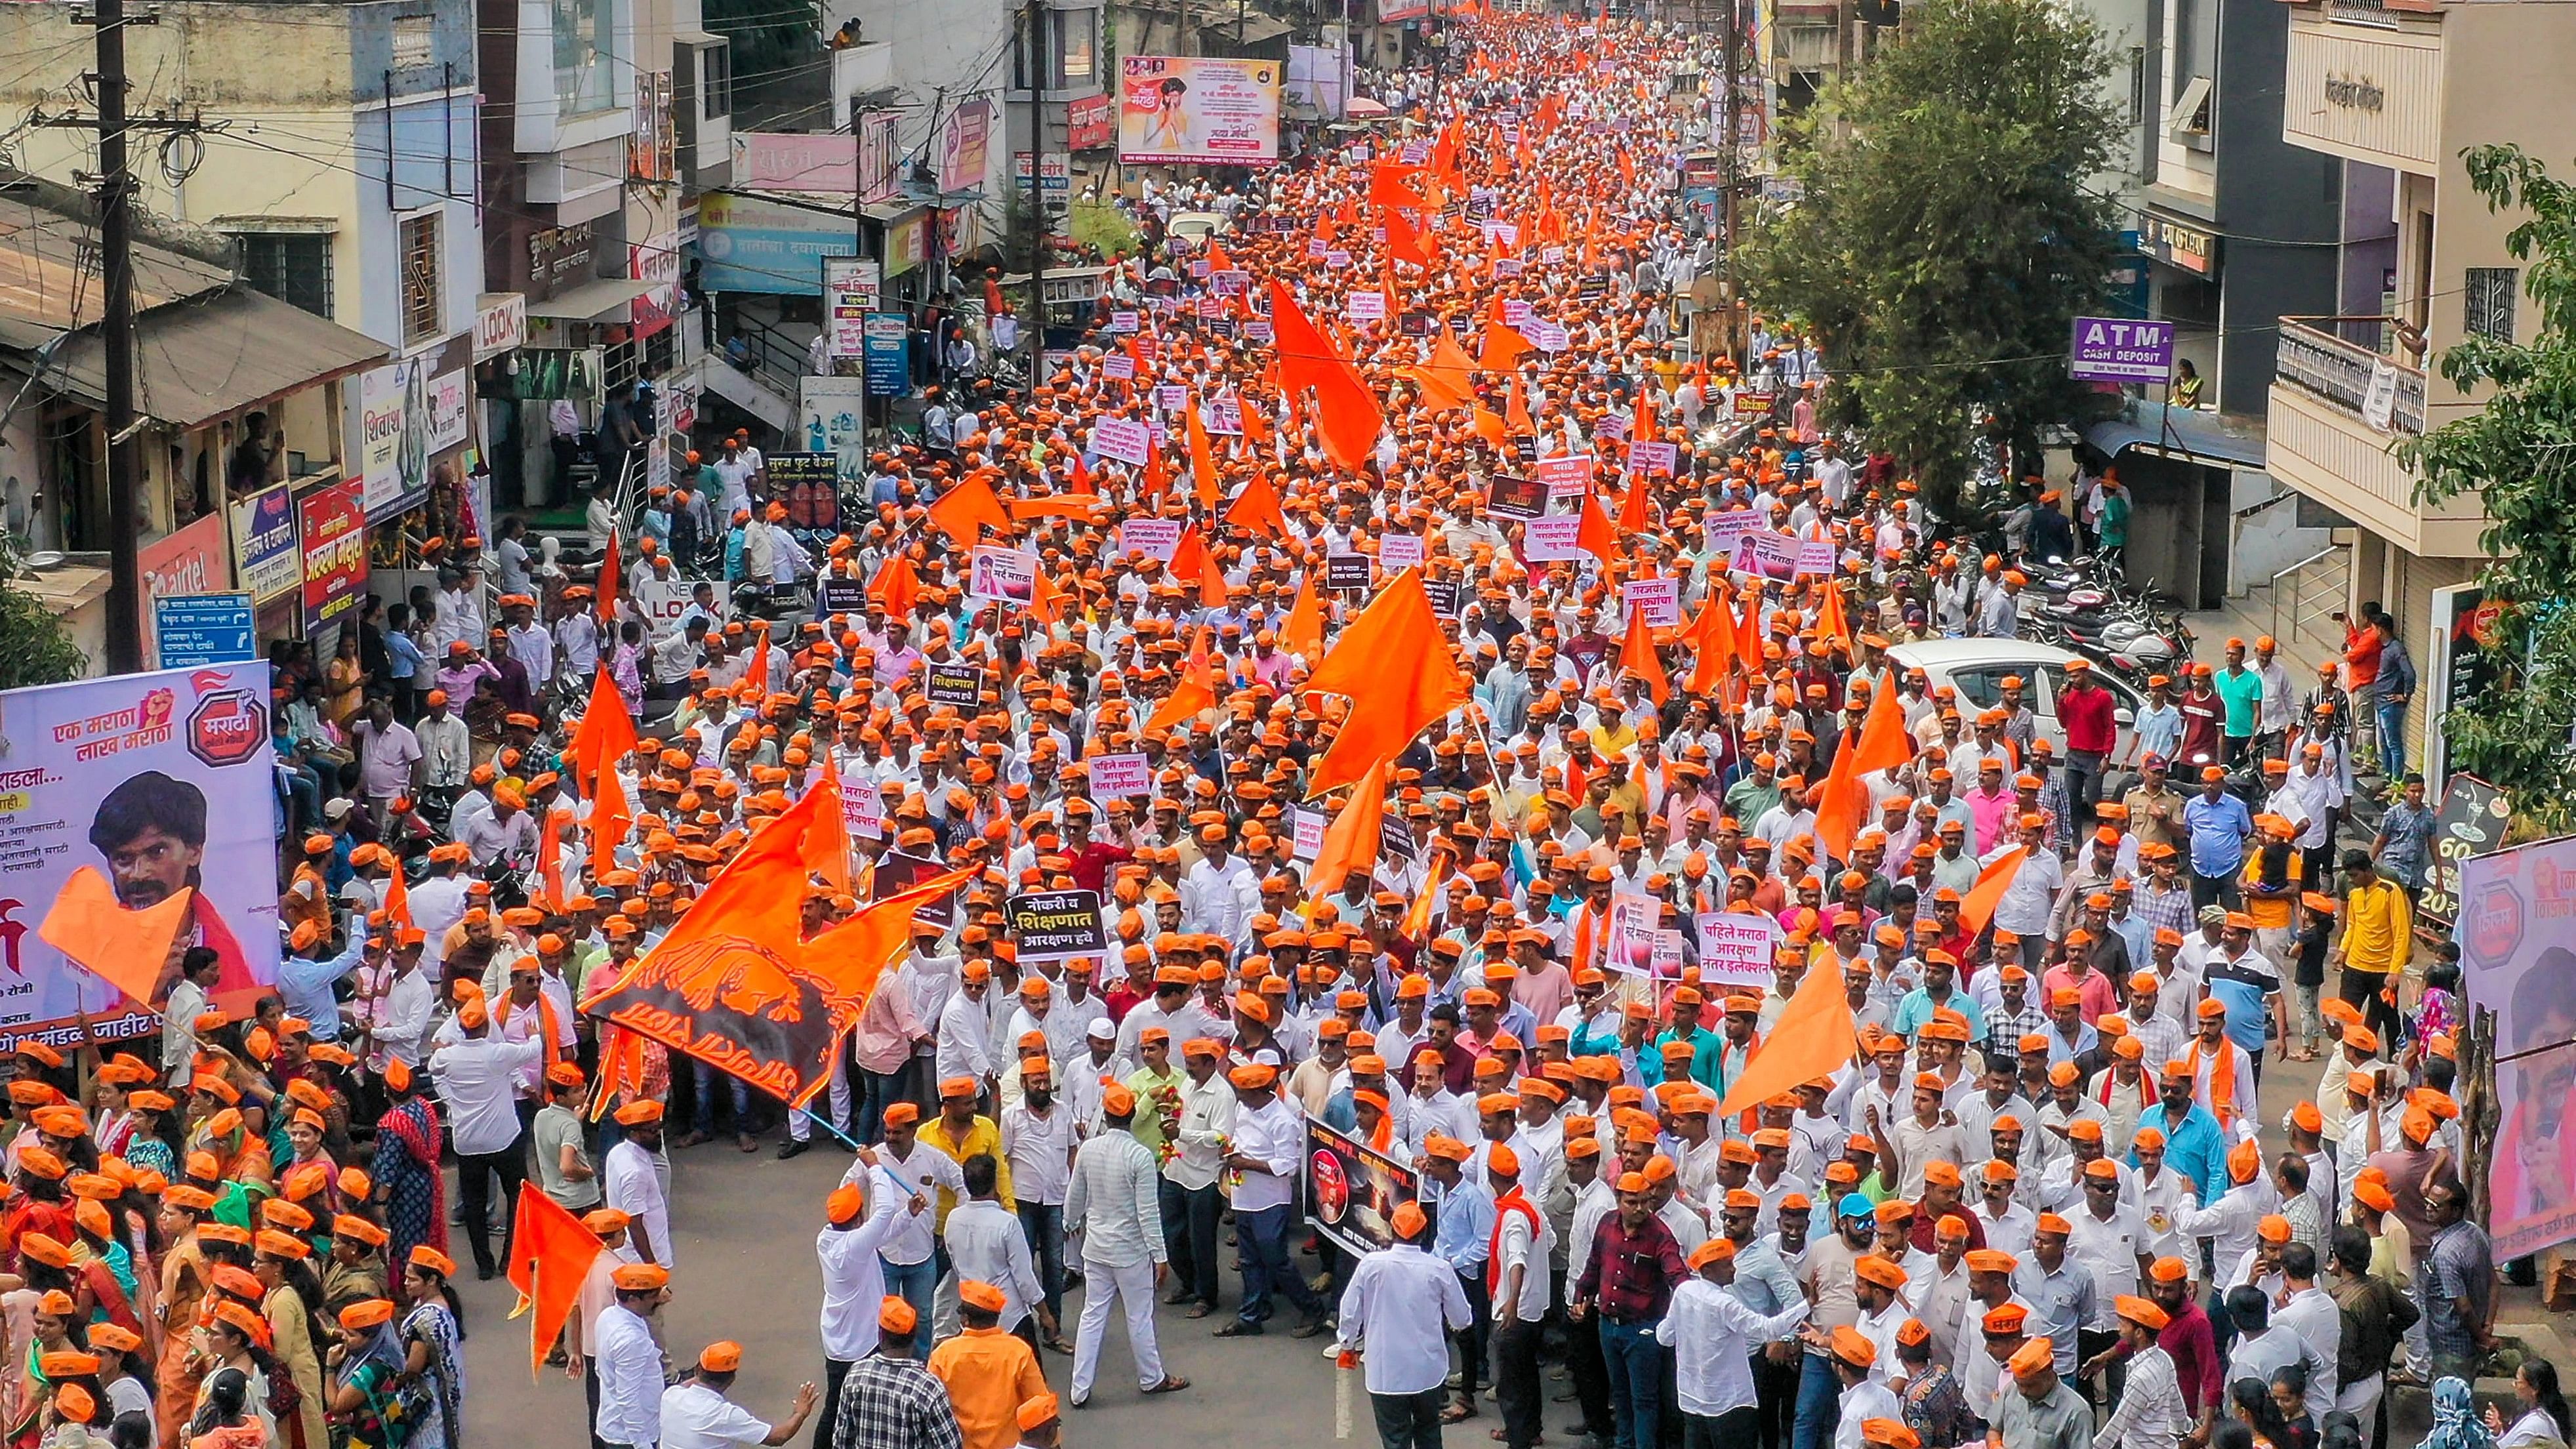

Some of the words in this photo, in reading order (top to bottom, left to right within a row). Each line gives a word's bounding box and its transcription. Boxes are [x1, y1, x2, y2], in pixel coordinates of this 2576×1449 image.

[1019, 159, 1065, 176] बेंलोर
[789, 241, 851, 256] दवाखाना
[482, 304, 515, 347] LOOK
[2085, 323, 2159, 348] ATM
[2083, 348, 2111, 360] CASH
[2116, 350, 2161, 363] DEPOSIT
[364, 405, 400, 445] शिवांश
[768, 457, 791, 472] सुरज
[794, 457, 810, 472] फुट
[813, 453, 835, 468] वेअर
[1756, 549, 1768, 560] मर्द
[1770, 554, 1795, 566] मराठा
[169, 552, 207, 594] airtel
[994, 567, 1007, 580] मर्द
[1008, 571, 1032, 583] मराठा
[1632, 582, 1667, 595] गरजवंत
[1628, 594, 1672, 607] माठ्यांचा
[652, 600, 721, 619] LOK
[164, 632, 190, 641] सोमवार
[165, 641, 194, 651] पाण्याची
[196, 640, 215, 649] टाकी
[931, 674, 975, 688] शिक्षणात
[940, 668, 963, 678] नोकरी
[932, 690, 960, 699] आरक्षण
[961, 691, 973, 700] हवे
[52, 720, 83, 743] एक
[86, 707, 136, 734] मराठा
[203, 714, 253, 736] मराठा
[75, 736, 119, 763] लाख
[123, 723, 173, 750] मराठा
[1094, 760, 1116, 771] पहिले
[1118, 760, 1141, 769] मराठा
[0, 767, 63, 792] राडला...
[1103, 769, 1134, 781] आरक्षण
[845, 786, 872, 800] मराठा
[1093, 779, 1113, 792] नंतर
[1114, 778, 1145, 791] इलेक्शन
[840, 798, 865, 813] रक्षण
[844, 812, 878, 828] लेक्शन
[0, 839, 25, 849] णाऱ्या
[2439, 838, 2476, 861] 60
[1026, 898, 1065, 911] नोकरी
[1069, 898, 1078, 910] व
[2419, 887, 2459, 918] 20₹
[1016, 912, 1093, 931] शिक्षणात
[1024, 933, 1073, 948] आरक्षण
[1074, 930, 1094, 945] हवे
[1625, 924, 1636, 941] मर्द
[1636, 929, 1654, 943] मराठा
[1705, 922, 1735, 939] पहिले
[1738, 928, 1767, 942] मराठा
[1716, 942, 1757, 960] आरक्षण
[1702, 955, 1725, 972] नंतर
[1727, 953, 1770, 975] इलेक्शन
[7, 983, 33, 997] रोजी
[1, 1012, 33, 1025] कराड
[611, 1001, 693, 1050] राजा
[0, 1030, 35, 1054] णेश
[39, 1023, 85, 1048] मंडळ
[92, 1012, 150, 1038] जाहीर
[685, 1032, 802, 1099] जाणता
